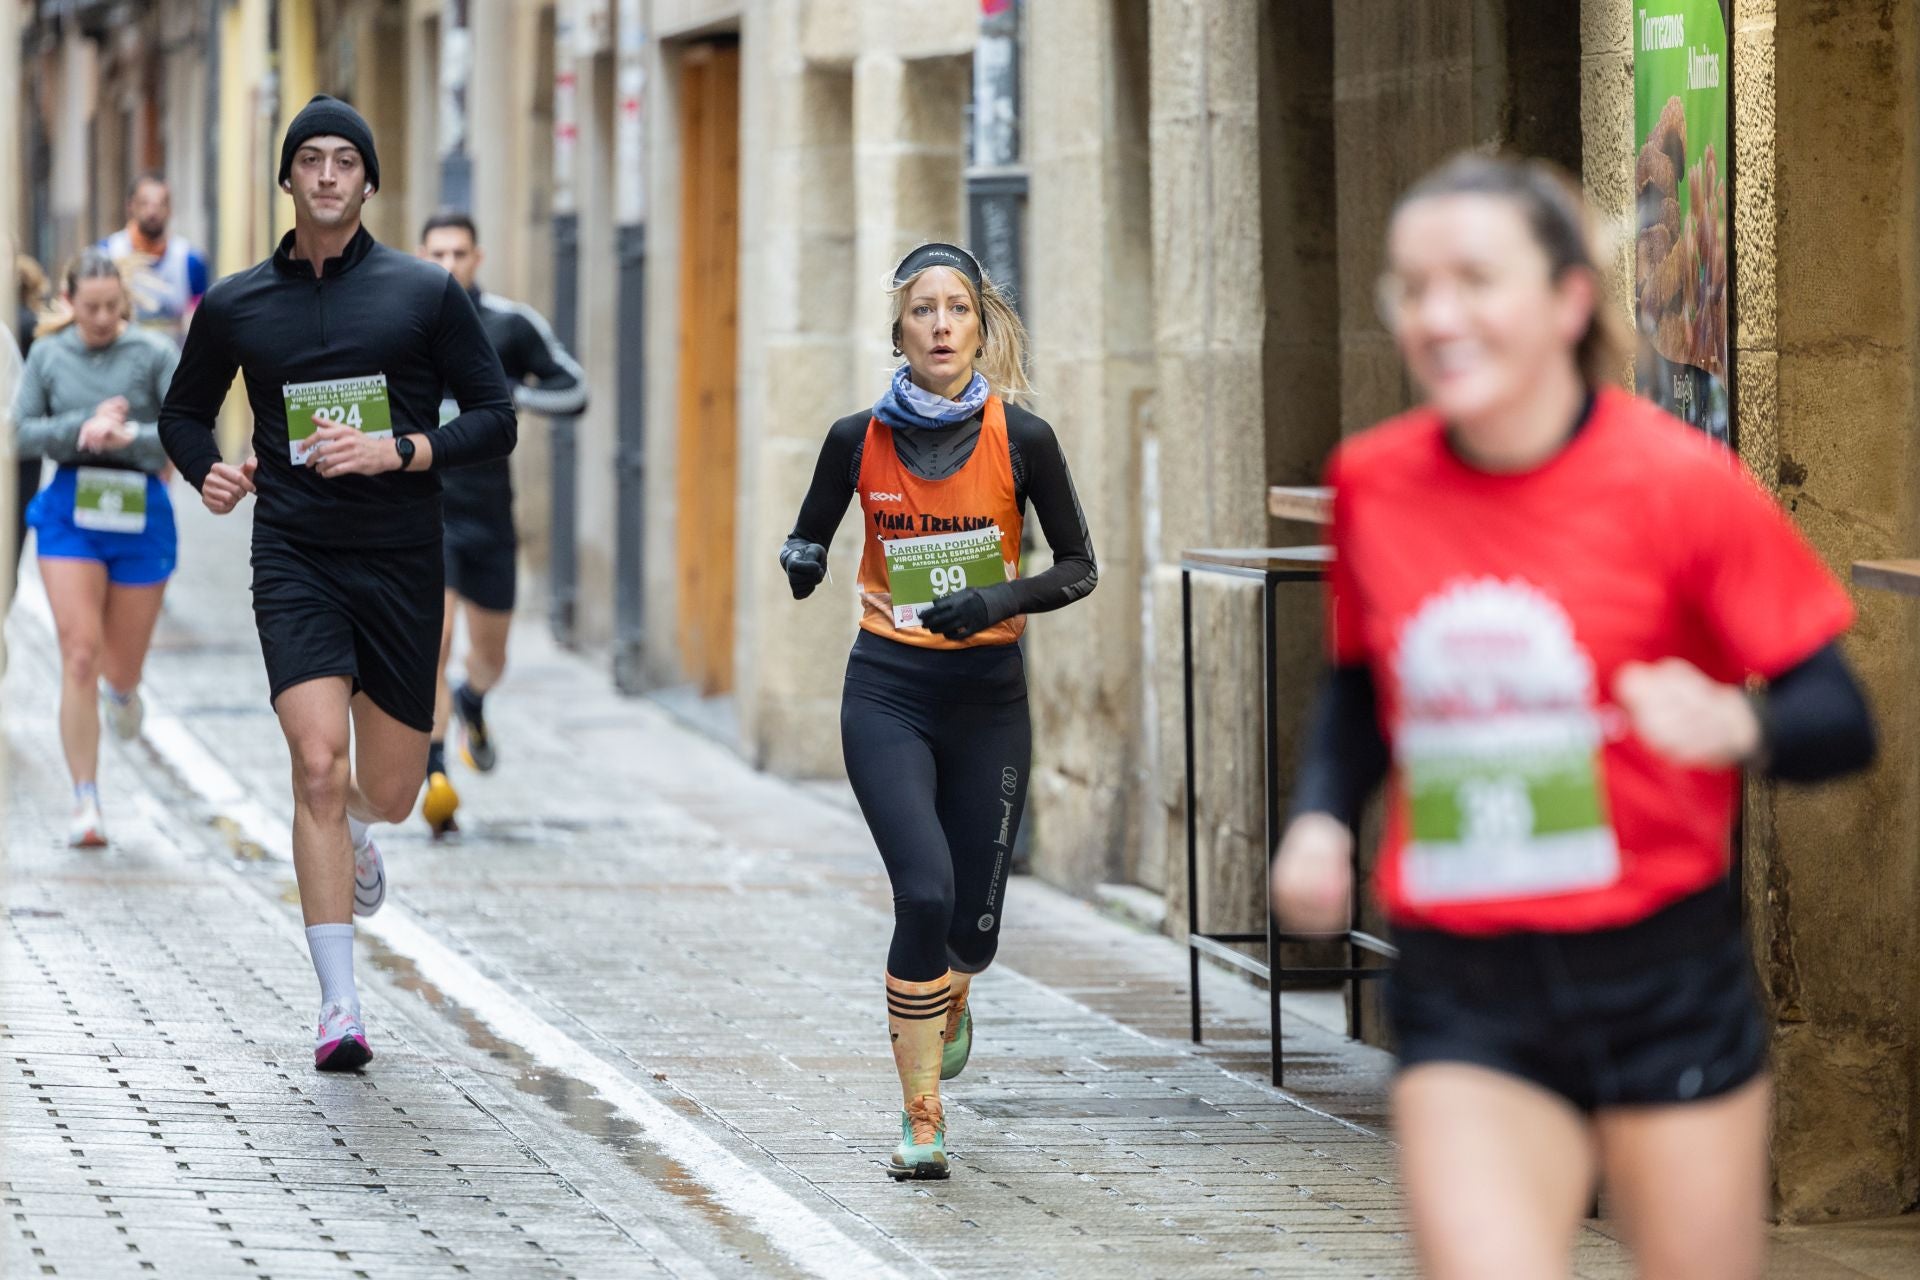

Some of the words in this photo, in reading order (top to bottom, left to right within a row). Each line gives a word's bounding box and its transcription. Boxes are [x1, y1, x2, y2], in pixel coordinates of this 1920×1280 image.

[1639, 8, 1684, 52] Torreznos
[1686, 43, 1719, 90] Almitas
[873, 510, 914, 531] VIANA
[890, 543, 941, 555] CARRERA
[944, 535, 997, 550] POPULAR
[894, 554, 923, 563] VIRGEN
[924, 552, 936, 560] DE
[937, 551, 948, 559] LA
[949, 544, 996, 556] ESPERANZA
[930, 565, 967, 596] 99
